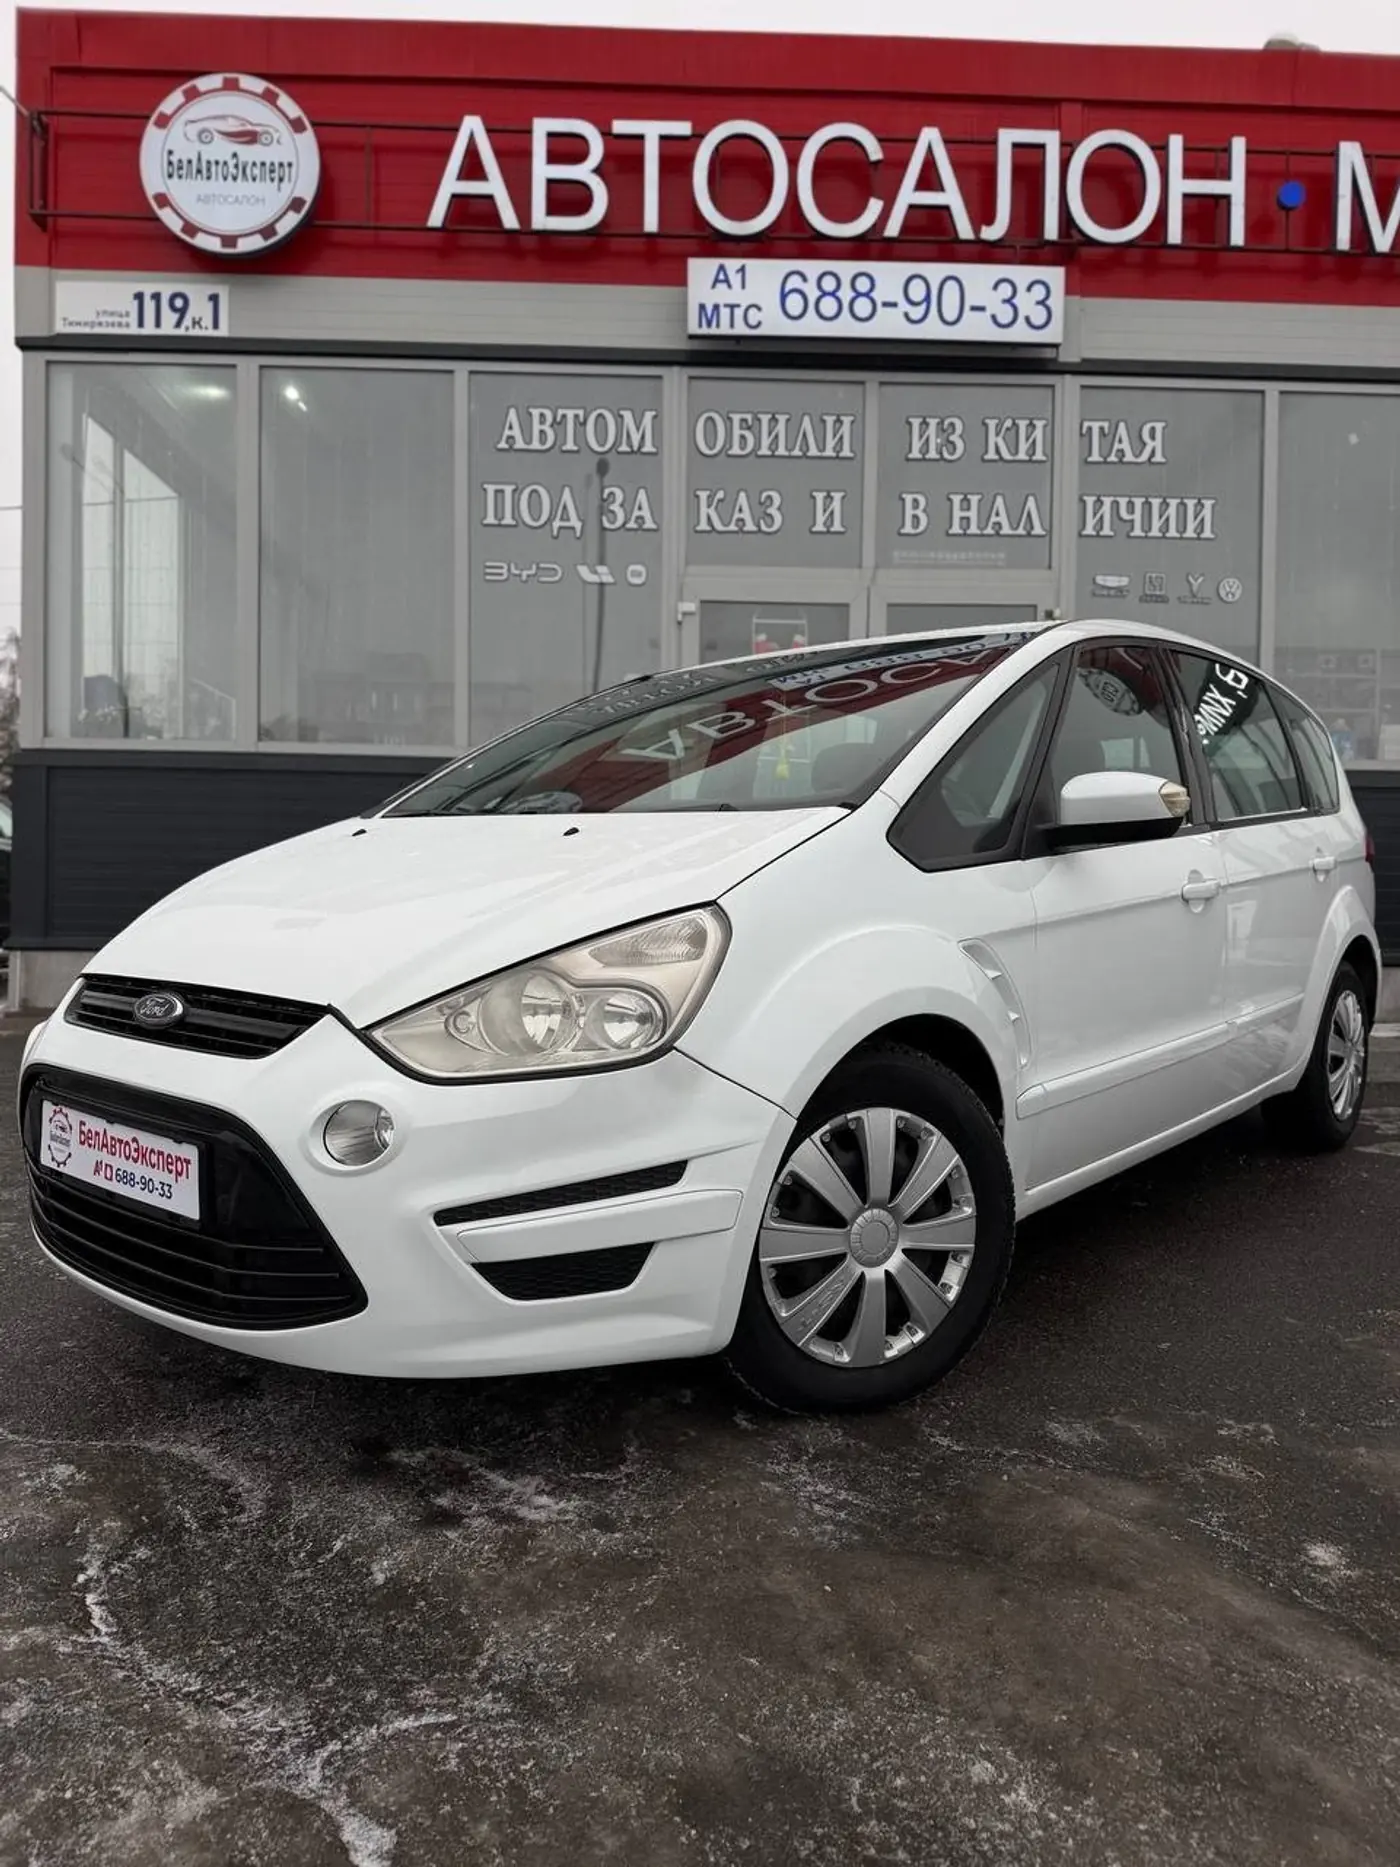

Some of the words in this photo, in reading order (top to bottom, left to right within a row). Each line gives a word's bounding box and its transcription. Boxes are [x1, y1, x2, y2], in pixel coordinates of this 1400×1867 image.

[166, 149, 293, 192] БелАвтоЭксперт
[426, 115, 1246, 247] АВТОСАЛОН
[196, 193, 266, 207] АВТОСАЛОН
[710, 263, 747, 290] A1
[95, 309, 130, 319] улица
[779, 270, 1053, 330] 688-90-33
[697, 304, 763, 329] МТС
[497, 407, 658, 453] АВТОМ
[694, 411, 855, 458] ОБИЛИ
[907, 416, 965, 461] ИЗ
[982, 418, 1048, 462] КИ
[1081, 421, 1167, 463] ТАЯ
[482, 484, 583, 538] ПОД
[601, 486, 658, 530] ЗА
[694, 489, 784, 533] КАЗ
[810, 491, 846, 532] И
[899, 493, 929, 536] В
[947, 493, 1047, 537] НАЛ
[1080, 495, 1216, 539] ИЧИИ
[484, 561, 563, 583] BYD
[139, 997, 171, 1017] Ford
[78, 1120, 191, 1183] БелАвтоЭксперт
[115, 1168, 173, 1199] 688-90-33
